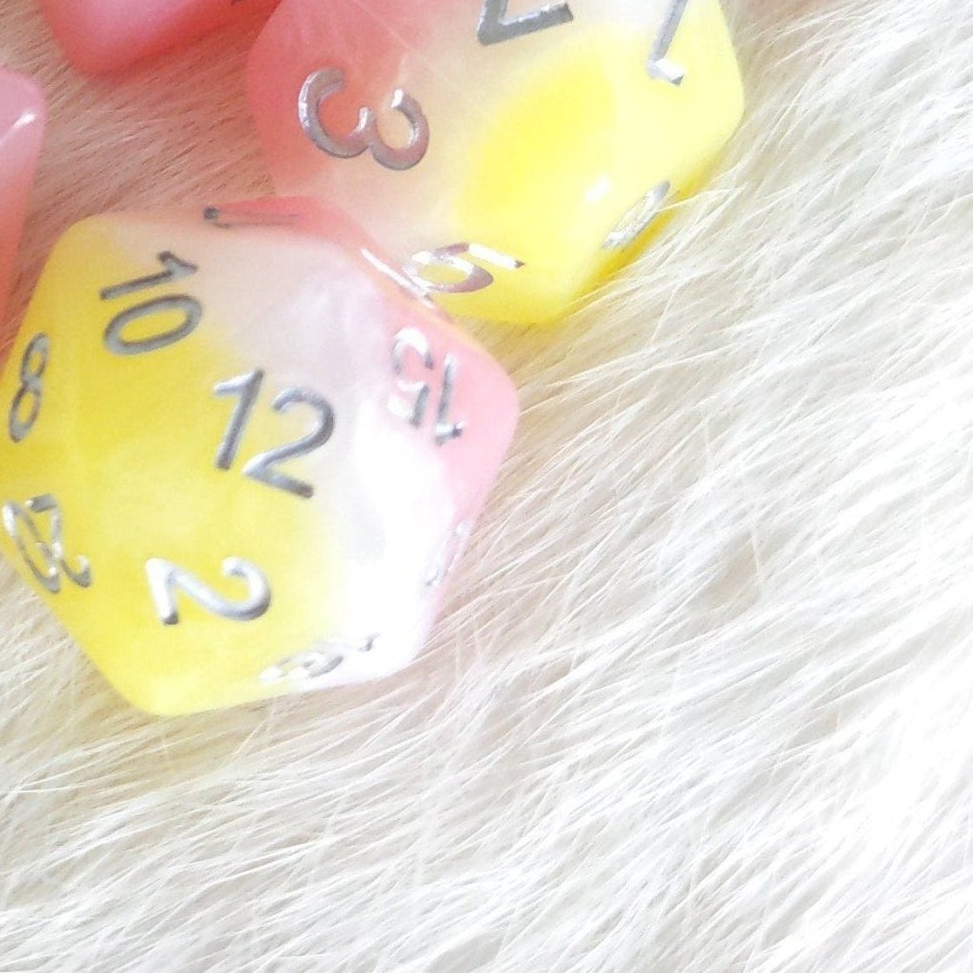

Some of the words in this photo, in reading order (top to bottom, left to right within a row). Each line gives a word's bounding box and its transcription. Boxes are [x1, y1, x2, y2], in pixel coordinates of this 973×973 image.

[297, 66, 430, 171] 3
[99, 250, 204, 358] 10
[8, 331, 49, 444] 8
[211, 367, 336, 499] 12
[387, 325, 465, 447] 15
[145, 556, 272, 626] 2
